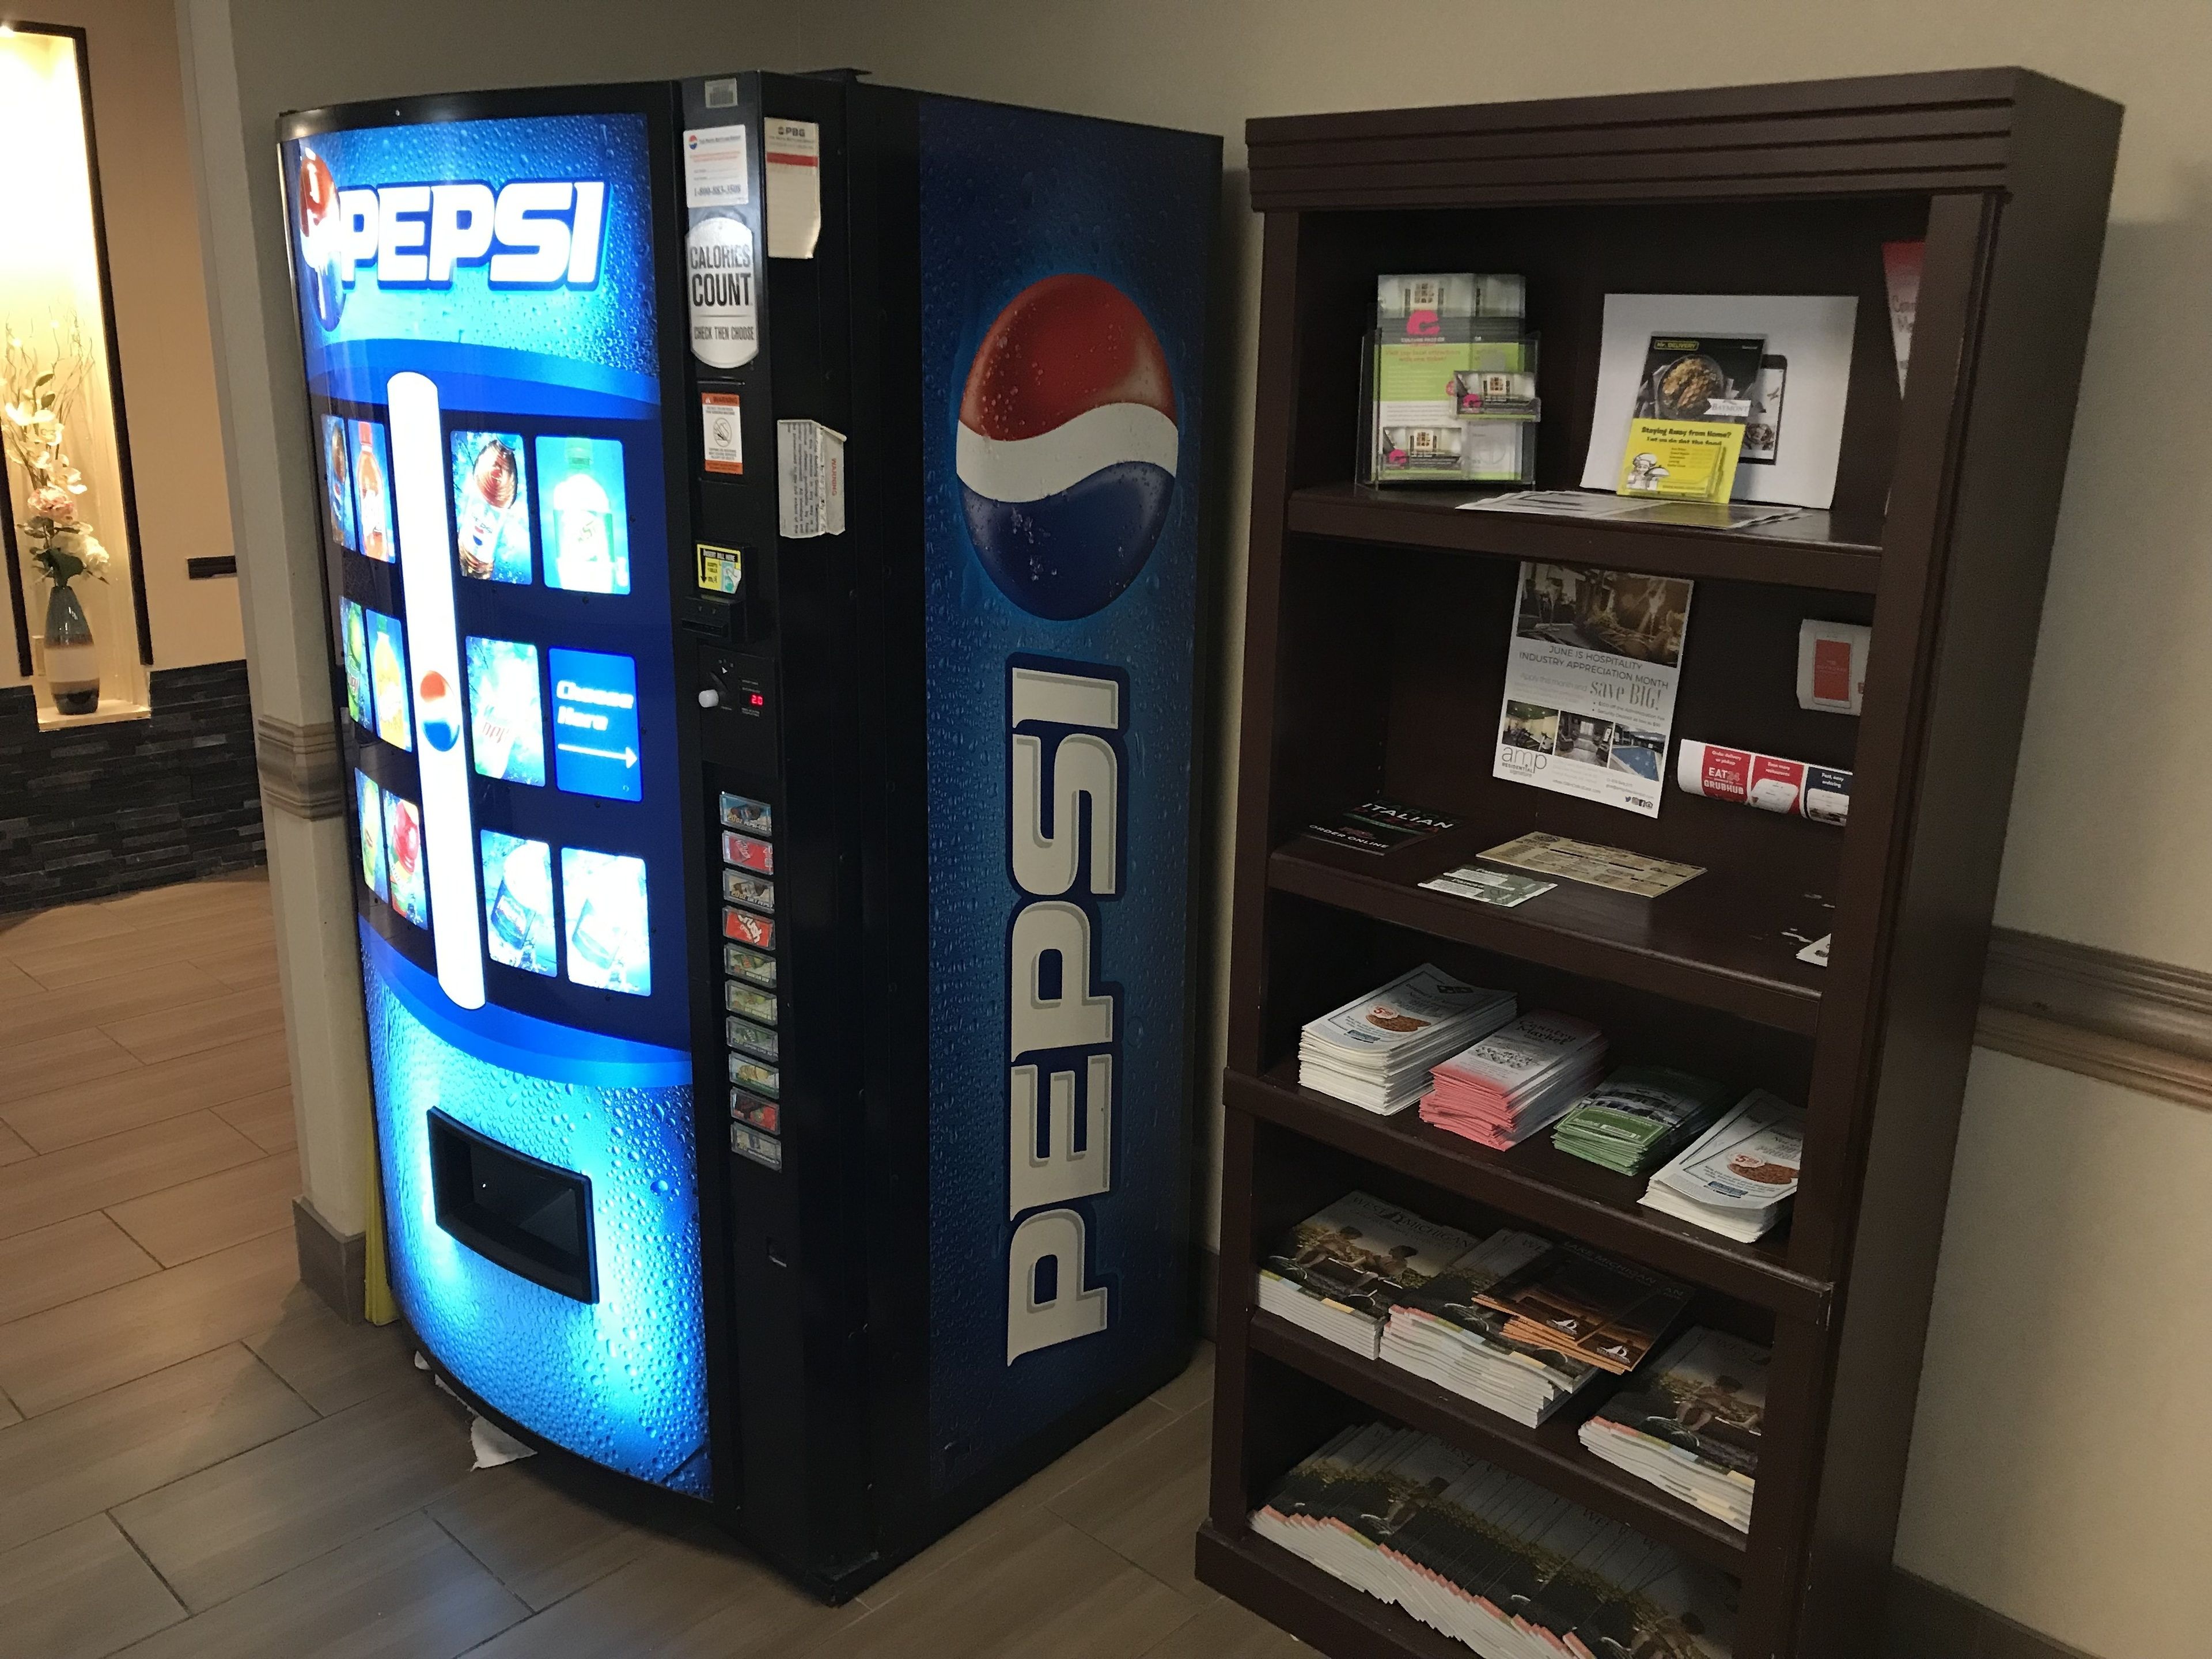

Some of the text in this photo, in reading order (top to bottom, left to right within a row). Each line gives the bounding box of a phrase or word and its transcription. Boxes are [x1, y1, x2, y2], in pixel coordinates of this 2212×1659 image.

[786, 126, 805, 137] PBG
[339, 180, 606, 285] PEPSI
[691, 244, 751, 269] CALORIES
[692, 272, 751, 306] COUNT
[694, 326, 755, 340] CHECK THEN CHOOSE
[1711, 403, 1749, 412] BAYMONT
[1642, 426, 1668, 436] Staying
[1668, 429, 1687, 437] Away
[717, 551, 725, 560] BILL
[725, 554, 736, 562] HERE
[1549, 645, 1643, 669] JUNE IS HOSPITALITY
[1519, 652, 1669, 690] INDUSTRY APPRECIATION MONTH
[1589, 680, 1625, 701] save
[1629, 683, 1662, 711] BIG!
[556, 705, 609, 731] Here
[1597, 708, 1616, 717] Security
[1502, 747, 1547, 774] amp
[1502, 762, 1533, 773] RESIDENTIAL
[1724, 752, 1742, 761] delivery
[1709, 767, 1740, 782] EAT24
[1703, 779, 1744, 796] GRUBHUB
[1361, 803, 1455, 828] ITALIAN
[1309, 824, 1390, 849] ORDER ONLINE
[1008, 667, 1119, 1367] PEPSI
[1514, 1024, 1566, 1046] Market
[1520, 1018, 1577, 1043] Country
[1353, 1196, 1474, 1248] WEST MICHIGAN
[1563, 1241, 1657, 1284] LAKE MICHIGAN
